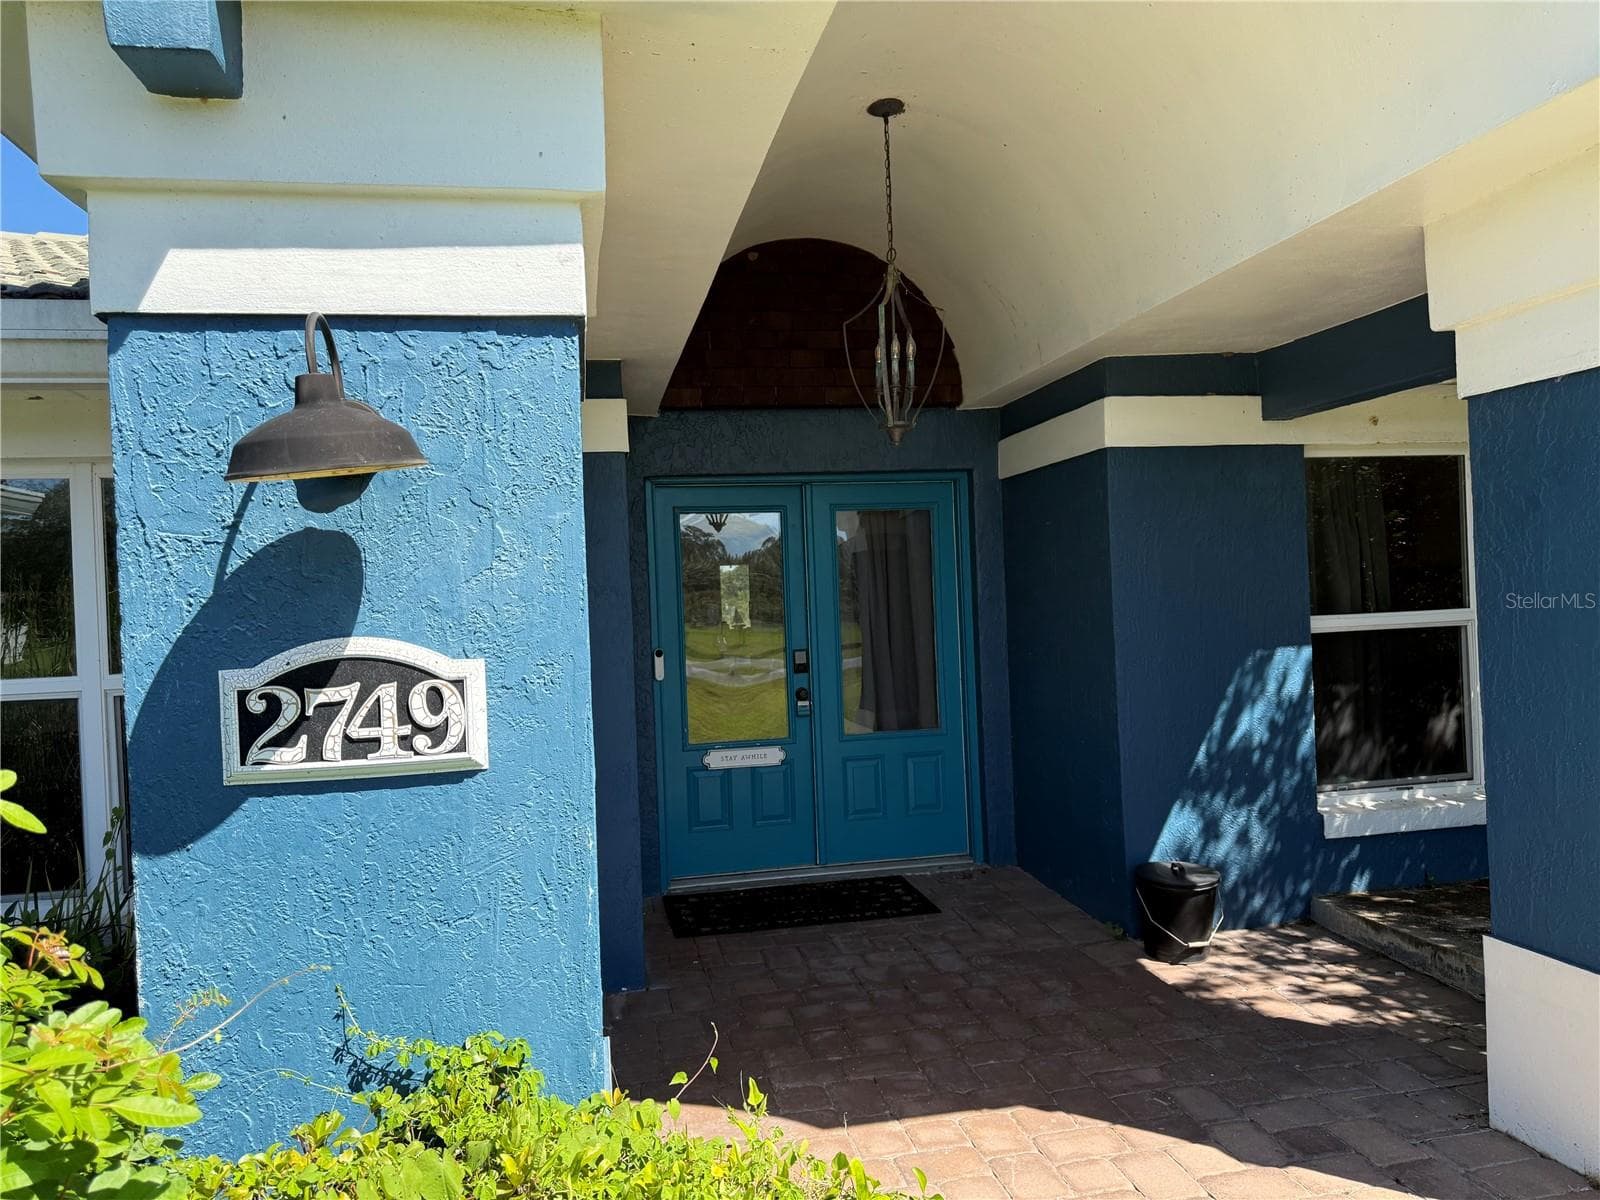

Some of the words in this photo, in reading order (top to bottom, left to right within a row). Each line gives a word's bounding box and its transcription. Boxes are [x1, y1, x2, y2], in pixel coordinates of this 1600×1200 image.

[245, 678, 466, 766] 2749
[720, 754, 738, 762] STAY
[740, 752, 768, 761] AWHILE
